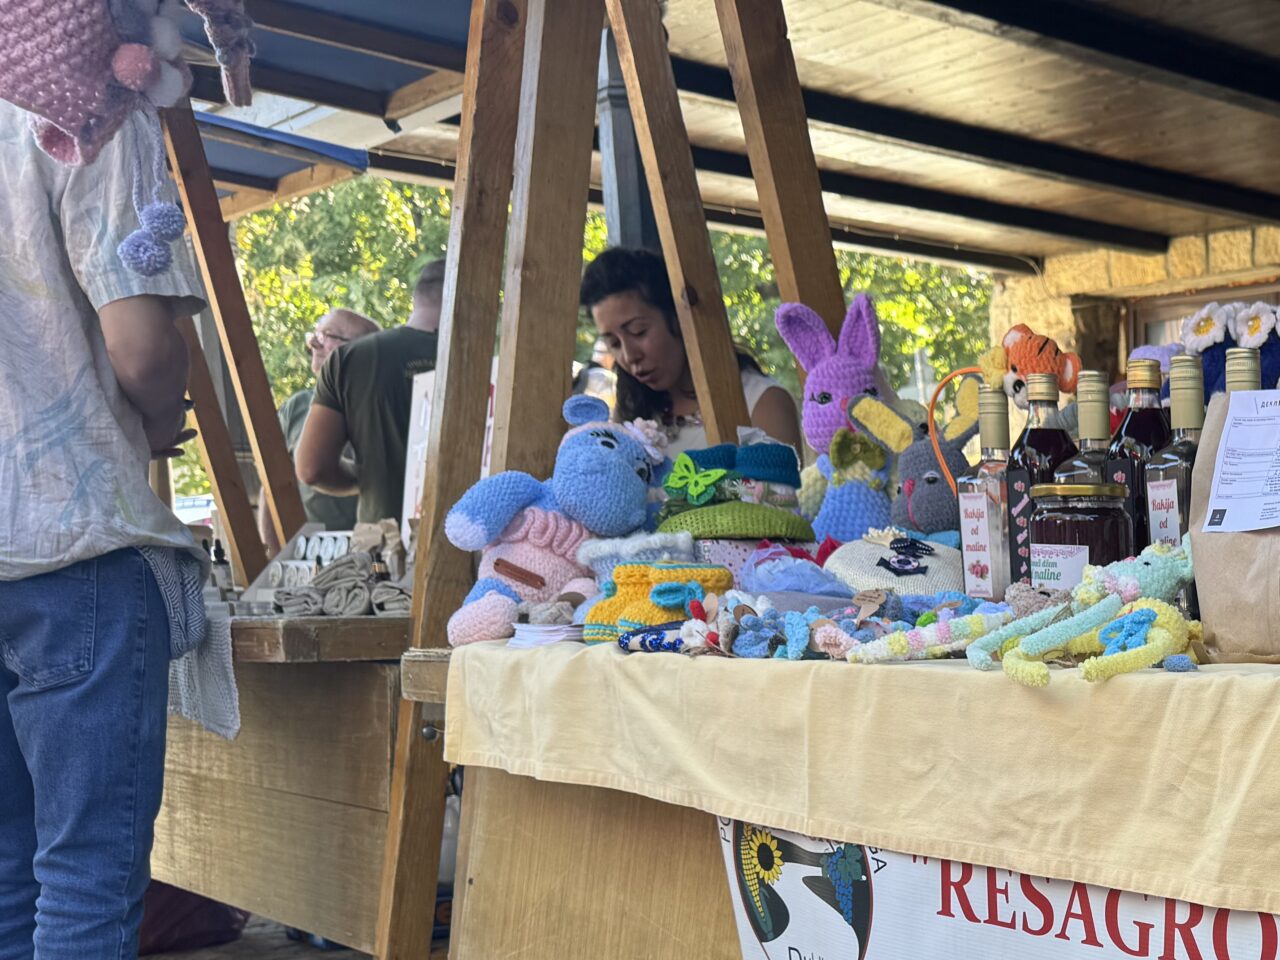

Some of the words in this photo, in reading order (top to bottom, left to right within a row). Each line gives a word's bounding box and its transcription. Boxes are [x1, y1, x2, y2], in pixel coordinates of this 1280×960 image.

[1152, 498, 1174, 513] Rakija
[964, 508, 985, 522] Rakija
[1159, 517, 1168, 529] od
[971, 525, 979, 536] od
[966, 541, 987, 552] maline
